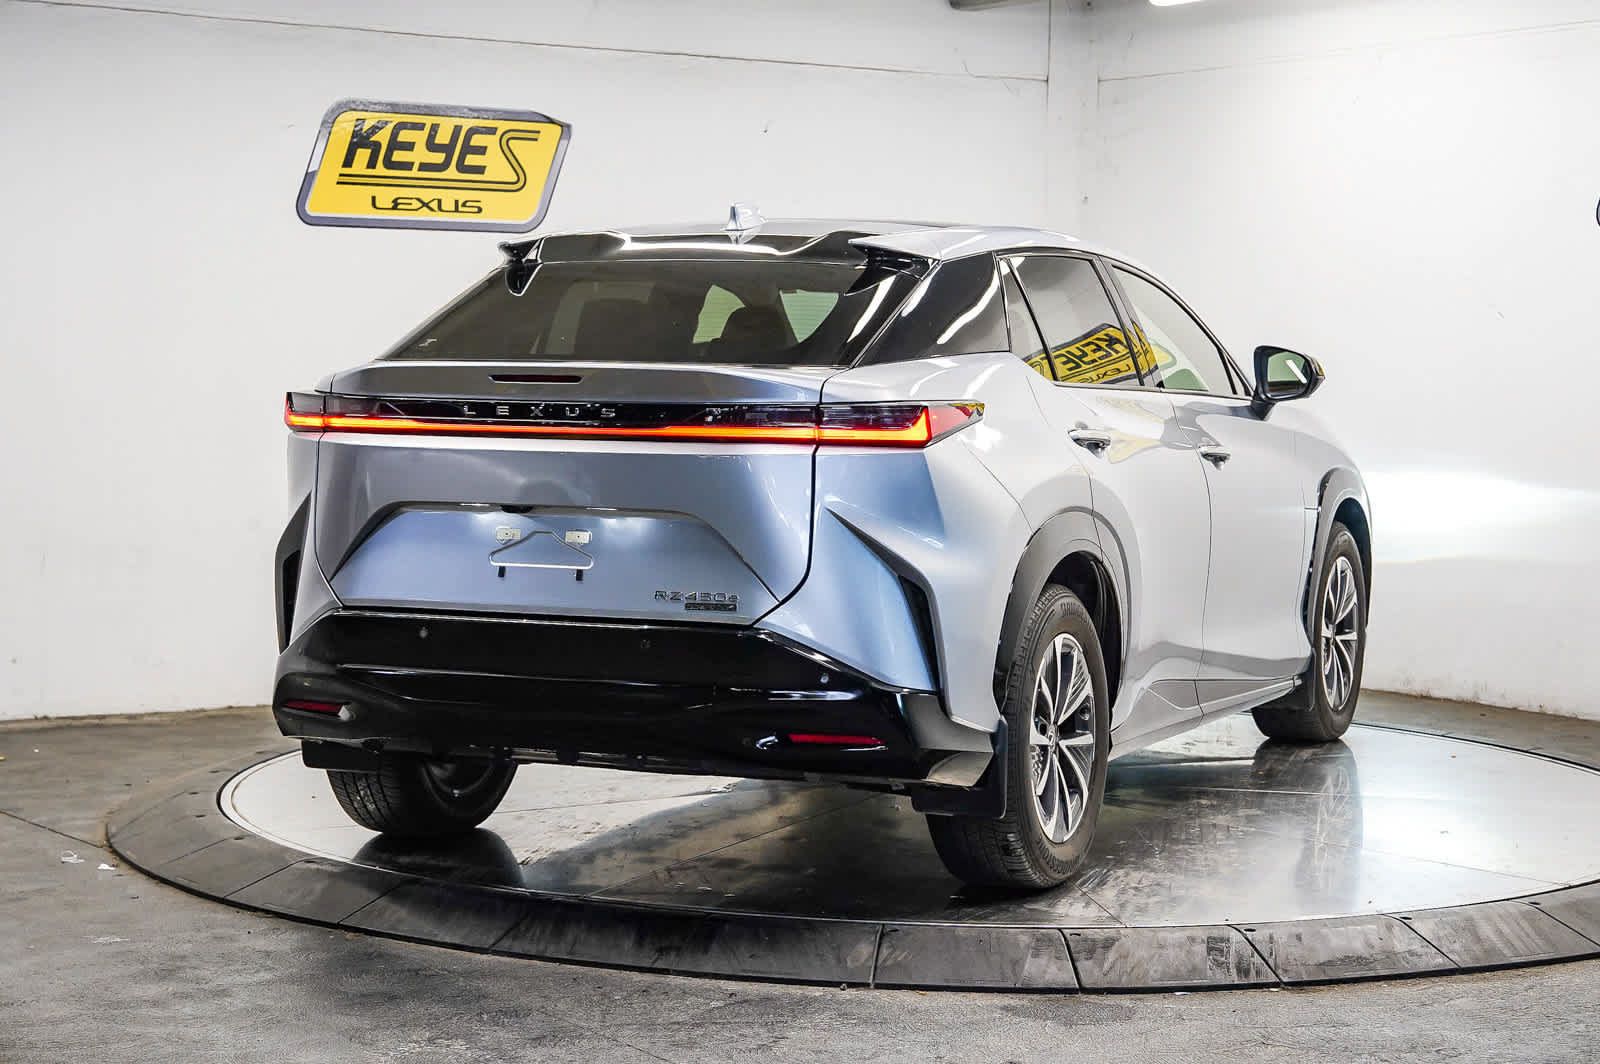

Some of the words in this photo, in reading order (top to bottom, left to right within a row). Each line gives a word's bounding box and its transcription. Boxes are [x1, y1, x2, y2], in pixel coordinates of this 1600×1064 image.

[338, 118, 540, 191] KEYES
[371, 195, 482, 214] LEXUS
[463, 404, 616, 419] LEXUS
